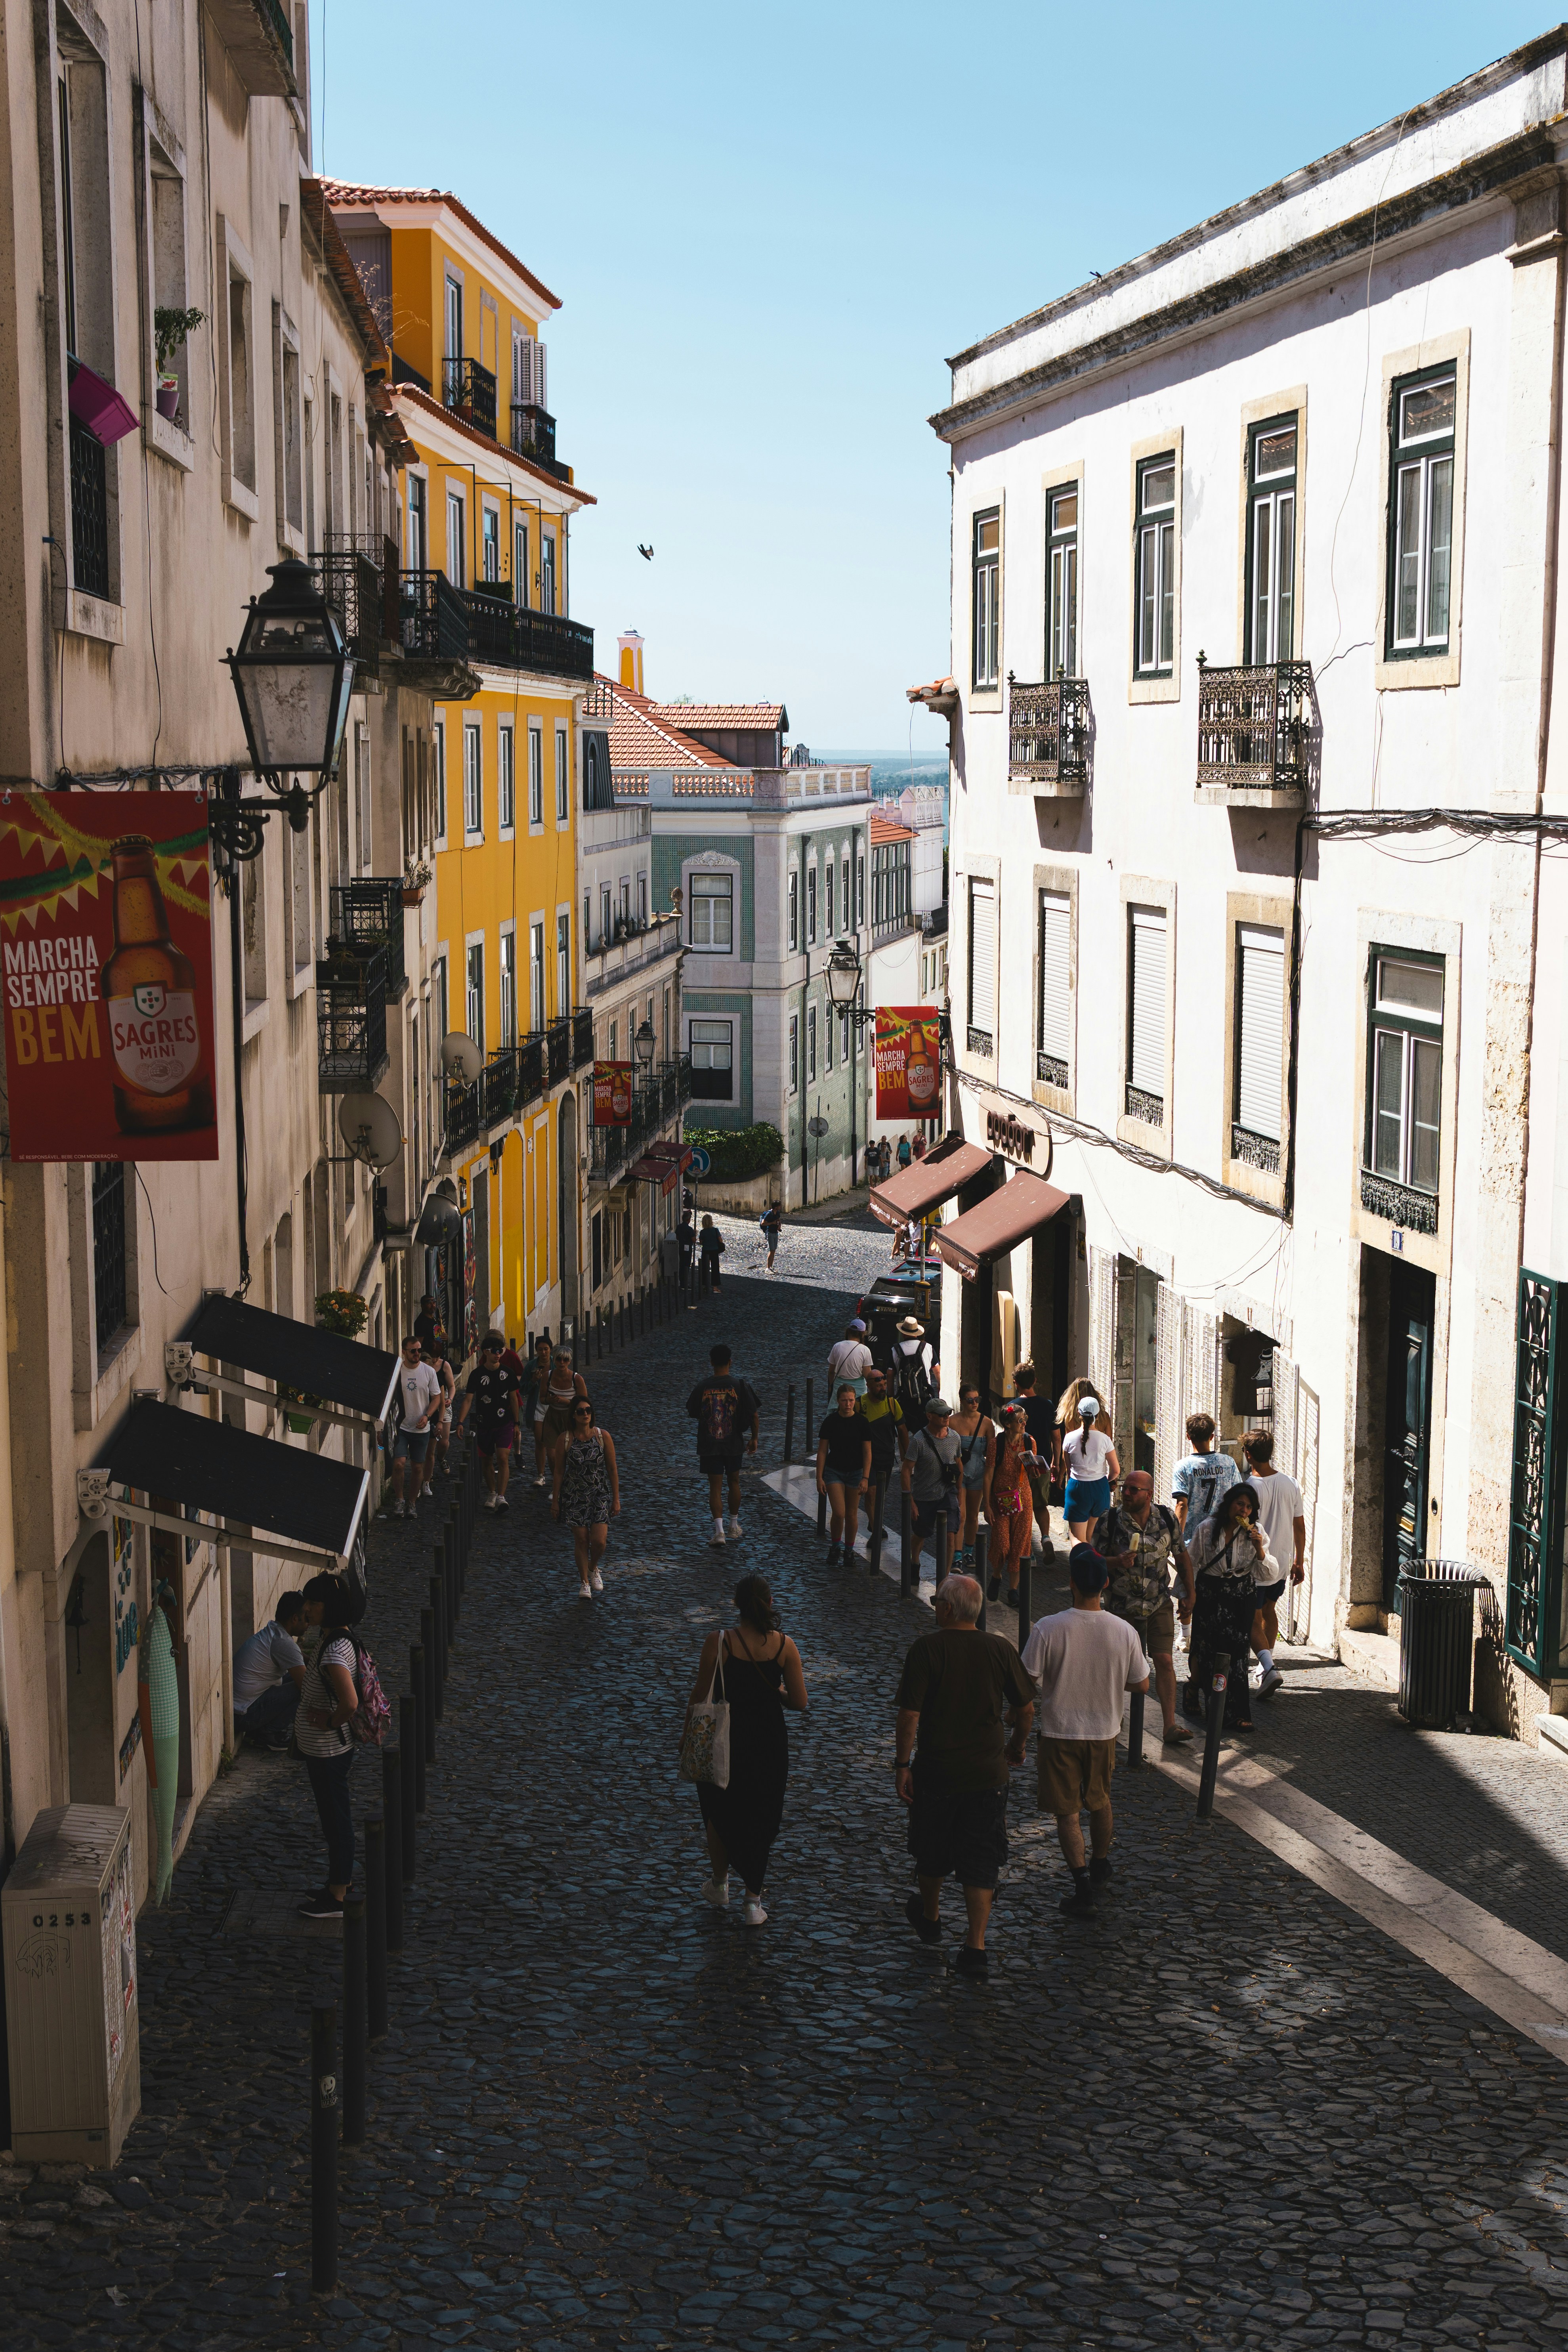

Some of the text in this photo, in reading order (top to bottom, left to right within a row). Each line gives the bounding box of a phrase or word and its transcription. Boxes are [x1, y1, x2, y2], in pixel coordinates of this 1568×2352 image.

[3, 935, 99, 974] MARCHA
[7, 969, 99, 1008] SEMPRE
[11, 1002, 101, 1065] BEM
[114, 1015, 196, 1051] SAGRES
[877, 1050, 905, 1062] MARCHA
[877, 1060, 905, 1072] SEMPRE
[878, 1070, 905, 1090] BEM
[909, 1074, 934, 1085] SAGRES
[596, 1097, 611, 1108] BEM
[1393, 1232, 1400, 1249] 19
[702, 1386, 738, 1398] METALLICA
[1193, 1466, 1223, 1477] RONALDO
[1201, 1478, 1217, 1513] 7
[33, 1913, 91, 1927] 0253
